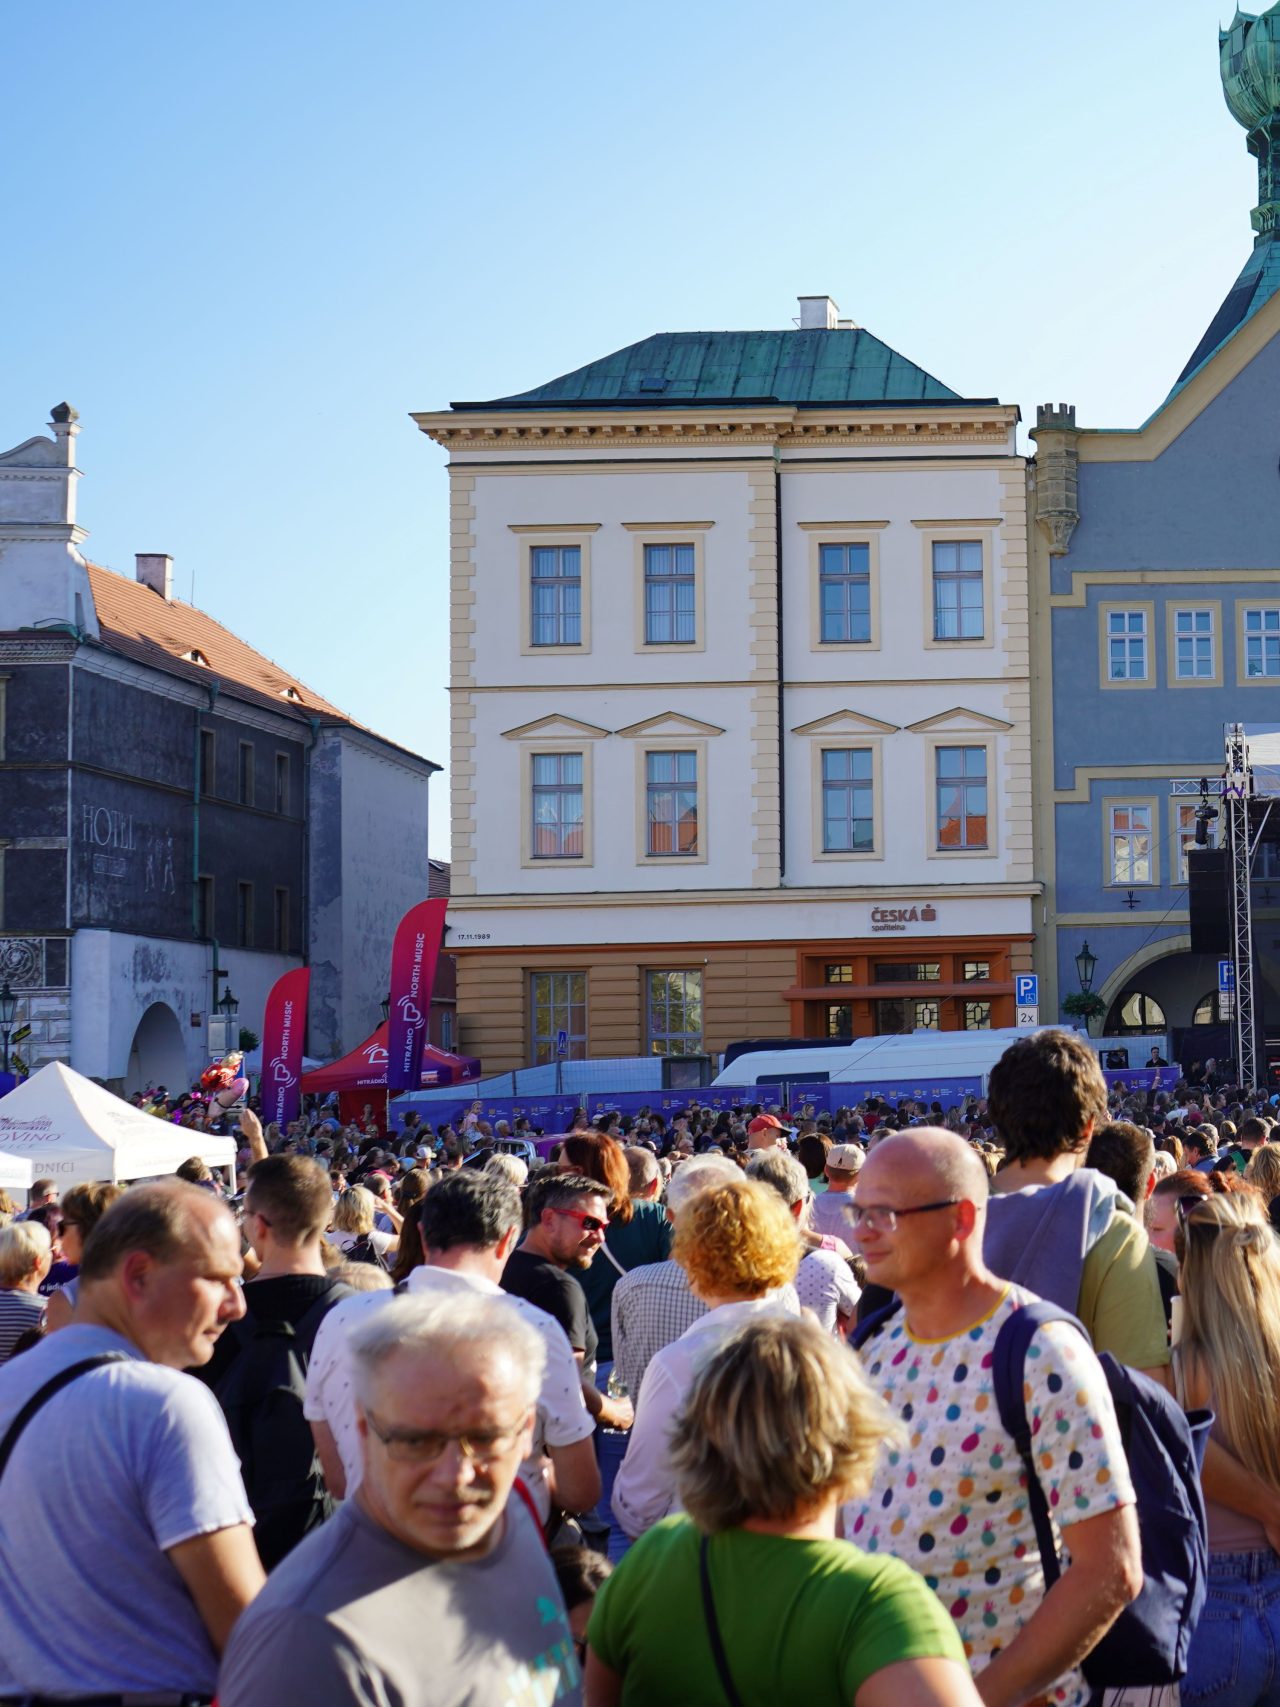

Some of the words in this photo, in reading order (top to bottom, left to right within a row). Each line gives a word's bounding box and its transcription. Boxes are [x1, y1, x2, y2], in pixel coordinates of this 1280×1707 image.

[82, 804, 136, 850] HOTEL
[871, 906, 919, 923] ČESKÁ
[871, 923, 906, 932] spořitelna
[414, 933, 426, 963] MUSIC
[410, 964, 421, 998] NORTH
[1020, 979, 1034, 997] P
[284, 1000, 293, 1027] MUSIC
[1020, 1013, 1034, 1023] 2x
[281, 1029, 290, 1060] NORTH
[403, 1028, 414, 1073] HITRÁDIO
[35, 1161, 75, 1173] DNICI
